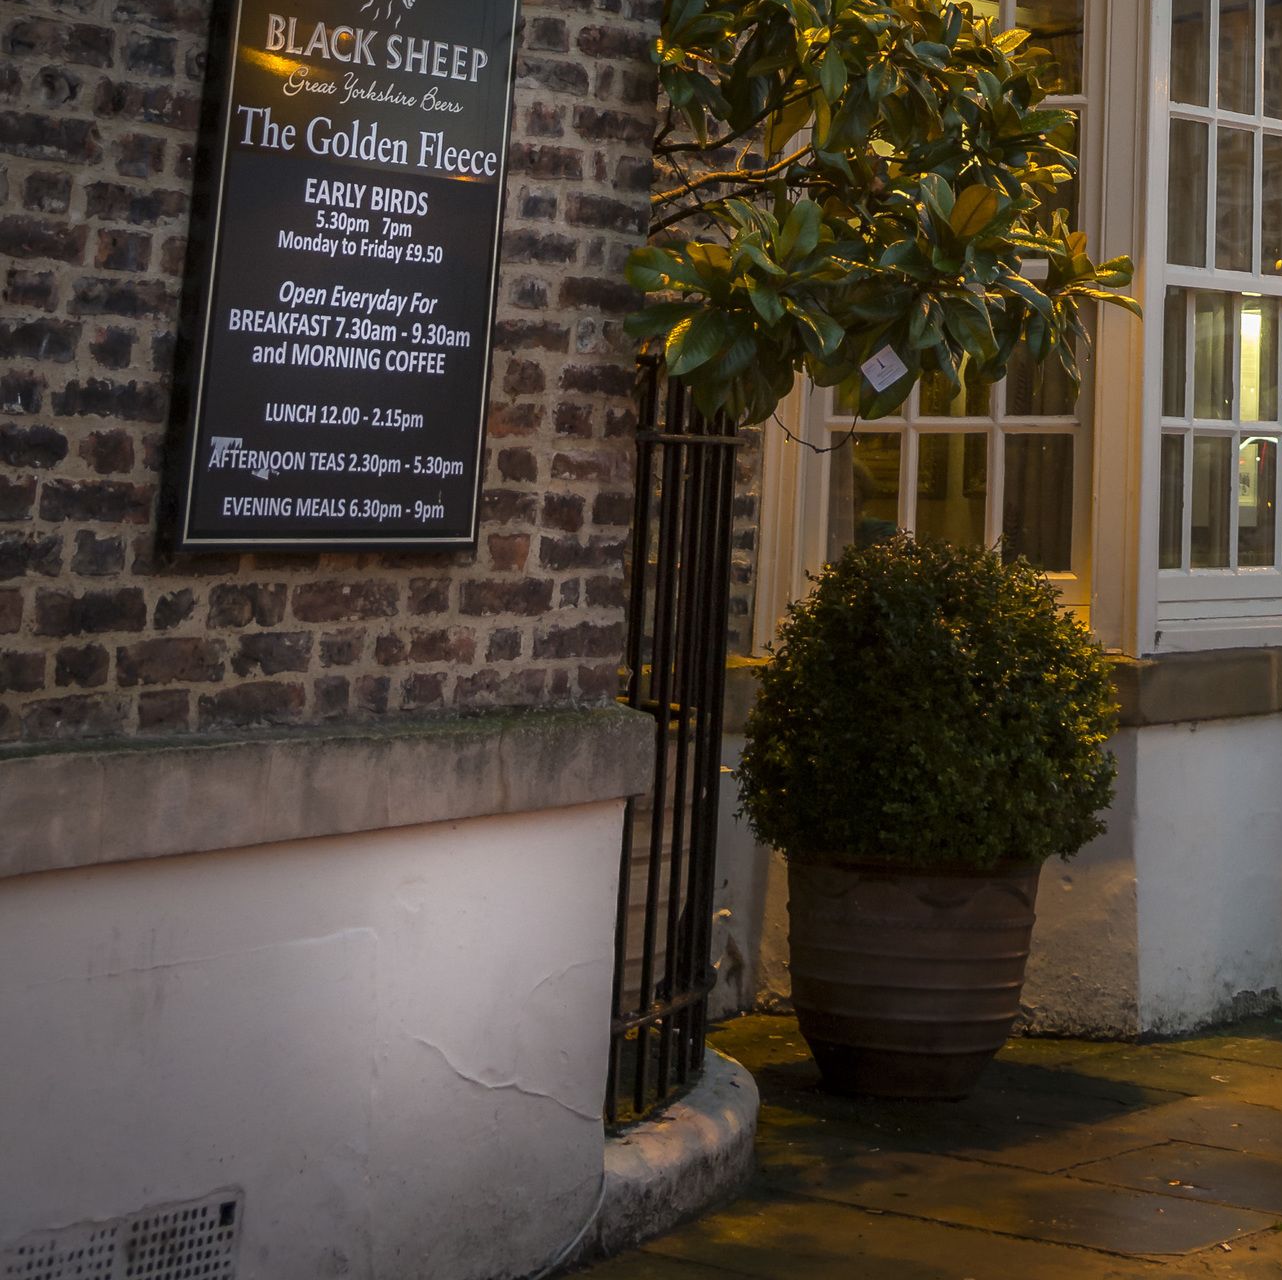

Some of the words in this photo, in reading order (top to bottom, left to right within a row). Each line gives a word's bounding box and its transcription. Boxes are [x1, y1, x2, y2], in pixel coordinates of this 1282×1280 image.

[265, 13, 378, 67] BLACK
[386, 34, 489, 83] SHEEP
[283, 66, 337, 96] Great
[340, 72, 417, 108] Yorkshire
[420, 86, 463, 113] Beers
[237, 104, 296, 151] The
[306, 116, 409, 165] Golden
[416, 131, 498, 177] Fleece
[304, 178, 367, 208] EARLY
[370, 187, 429, 216] BIRDS
[316, 210, 369, 235] 5.30pm
[382, 217, 412, 240] 7pm
[278, 230, 339, 257] Monday
[342, 238, 357, 256] to
[360, 238, 403, 264] Friday
[405, 243, 443, 264] £9.50
[279, 280, 327, 308] Open
[330, 285, 408, 317] Everyday
[410, 292, 438, 315] For
[229, 308, 331, 337] BREAKFAST
[335, 316, 397, 342] 7.30am
[411, 322, 471, 347] 9.30am
[252, 341, 288, 364] and
[291, 343, 381, 370] MORNING
[385, 350, 446, 374] COFFEE
[265, 402, 316, 423] LUNCH
[320, 405, 360, 425] 12.00
[371, 408, 424, 432] 2.15pm
[208, 449, 305, 471] AFTERNOON
[309, 452, 345, 472] TEAS
[348, 453, 401, 477] 2.30pm
[413, 456, 464, 478] 5.30pm
[223, 496, 292, 517] EVENING
[296, 498, 346, 517] MEALS
[349, 499, 401, 522] 6.30pm
[414, 500, 444, 523] 9pm
